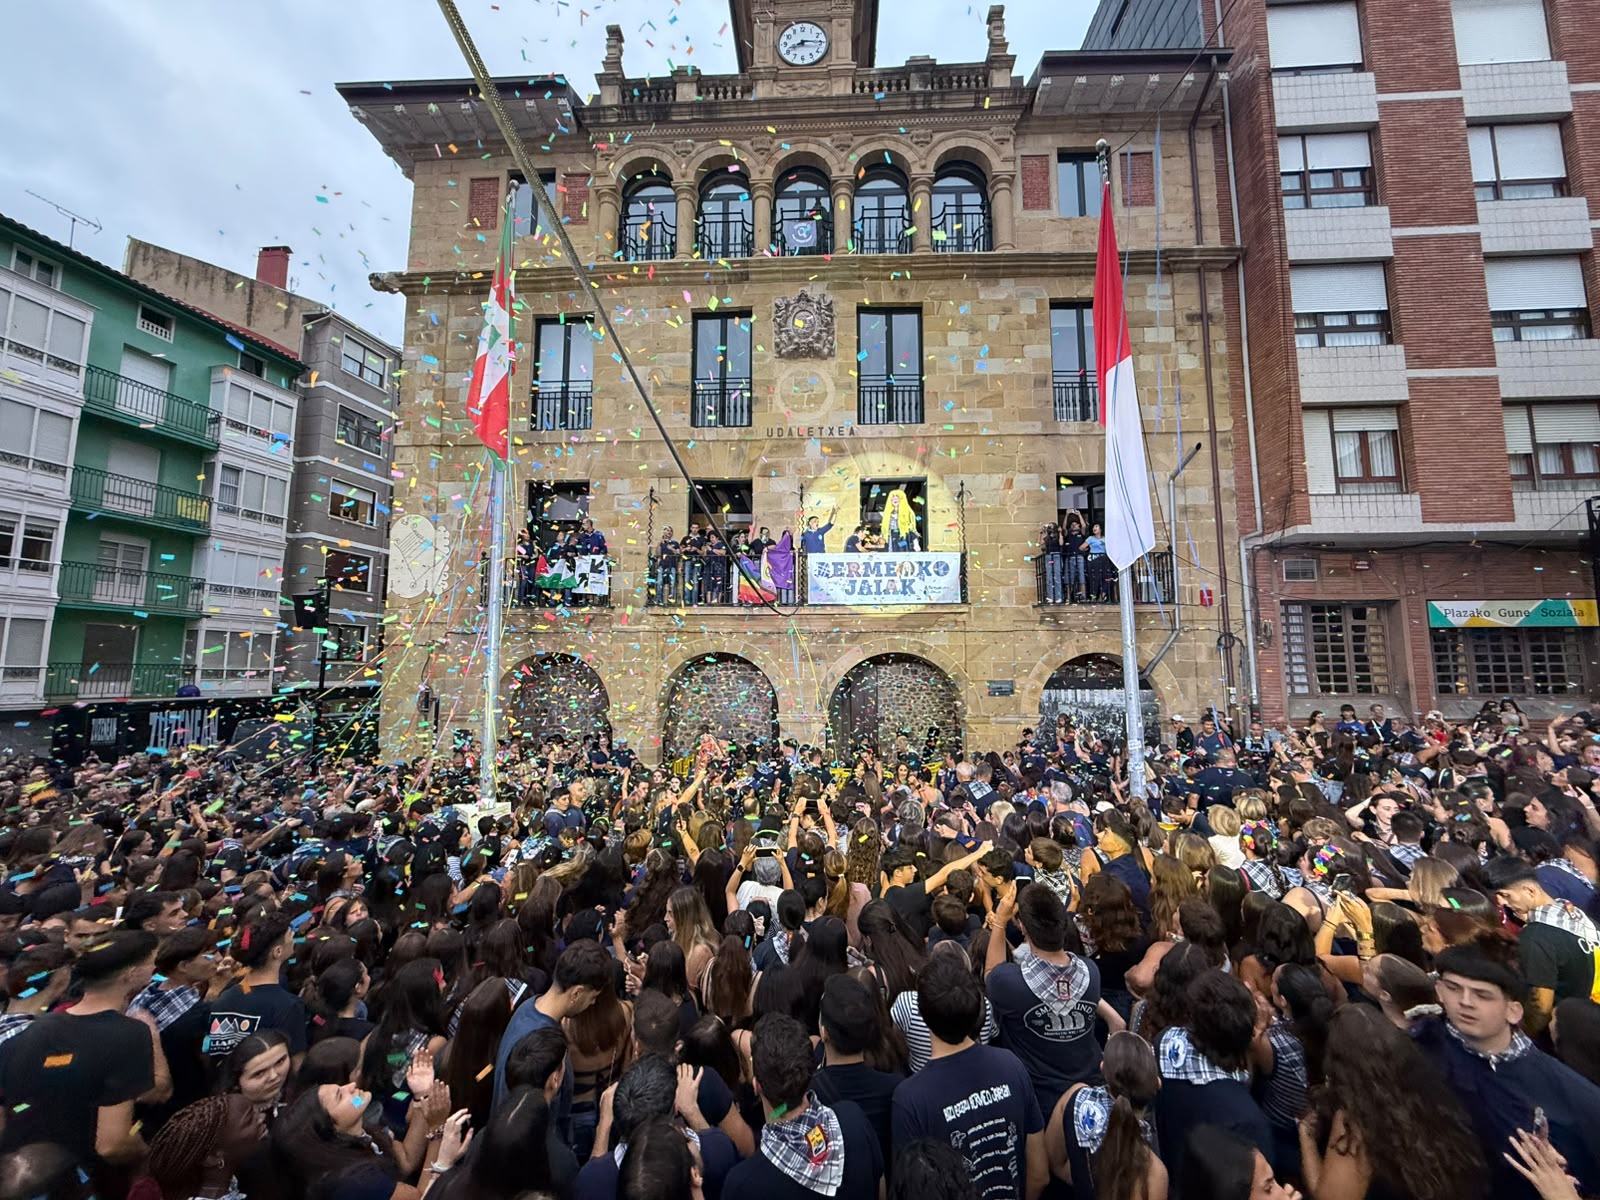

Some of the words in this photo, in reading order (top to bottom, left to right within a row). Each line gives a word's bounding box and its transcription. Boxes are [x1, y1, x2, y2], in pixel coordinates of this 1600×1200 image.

[766, 426, 855, 437] UDALETXEA
[845, 578, 916, 596] JAIAK
[1444, 608, 1491, 618] Plazako
[1498, 608, 1531, 618] Gune
[1541, 607, 1585, 618] Soziala
